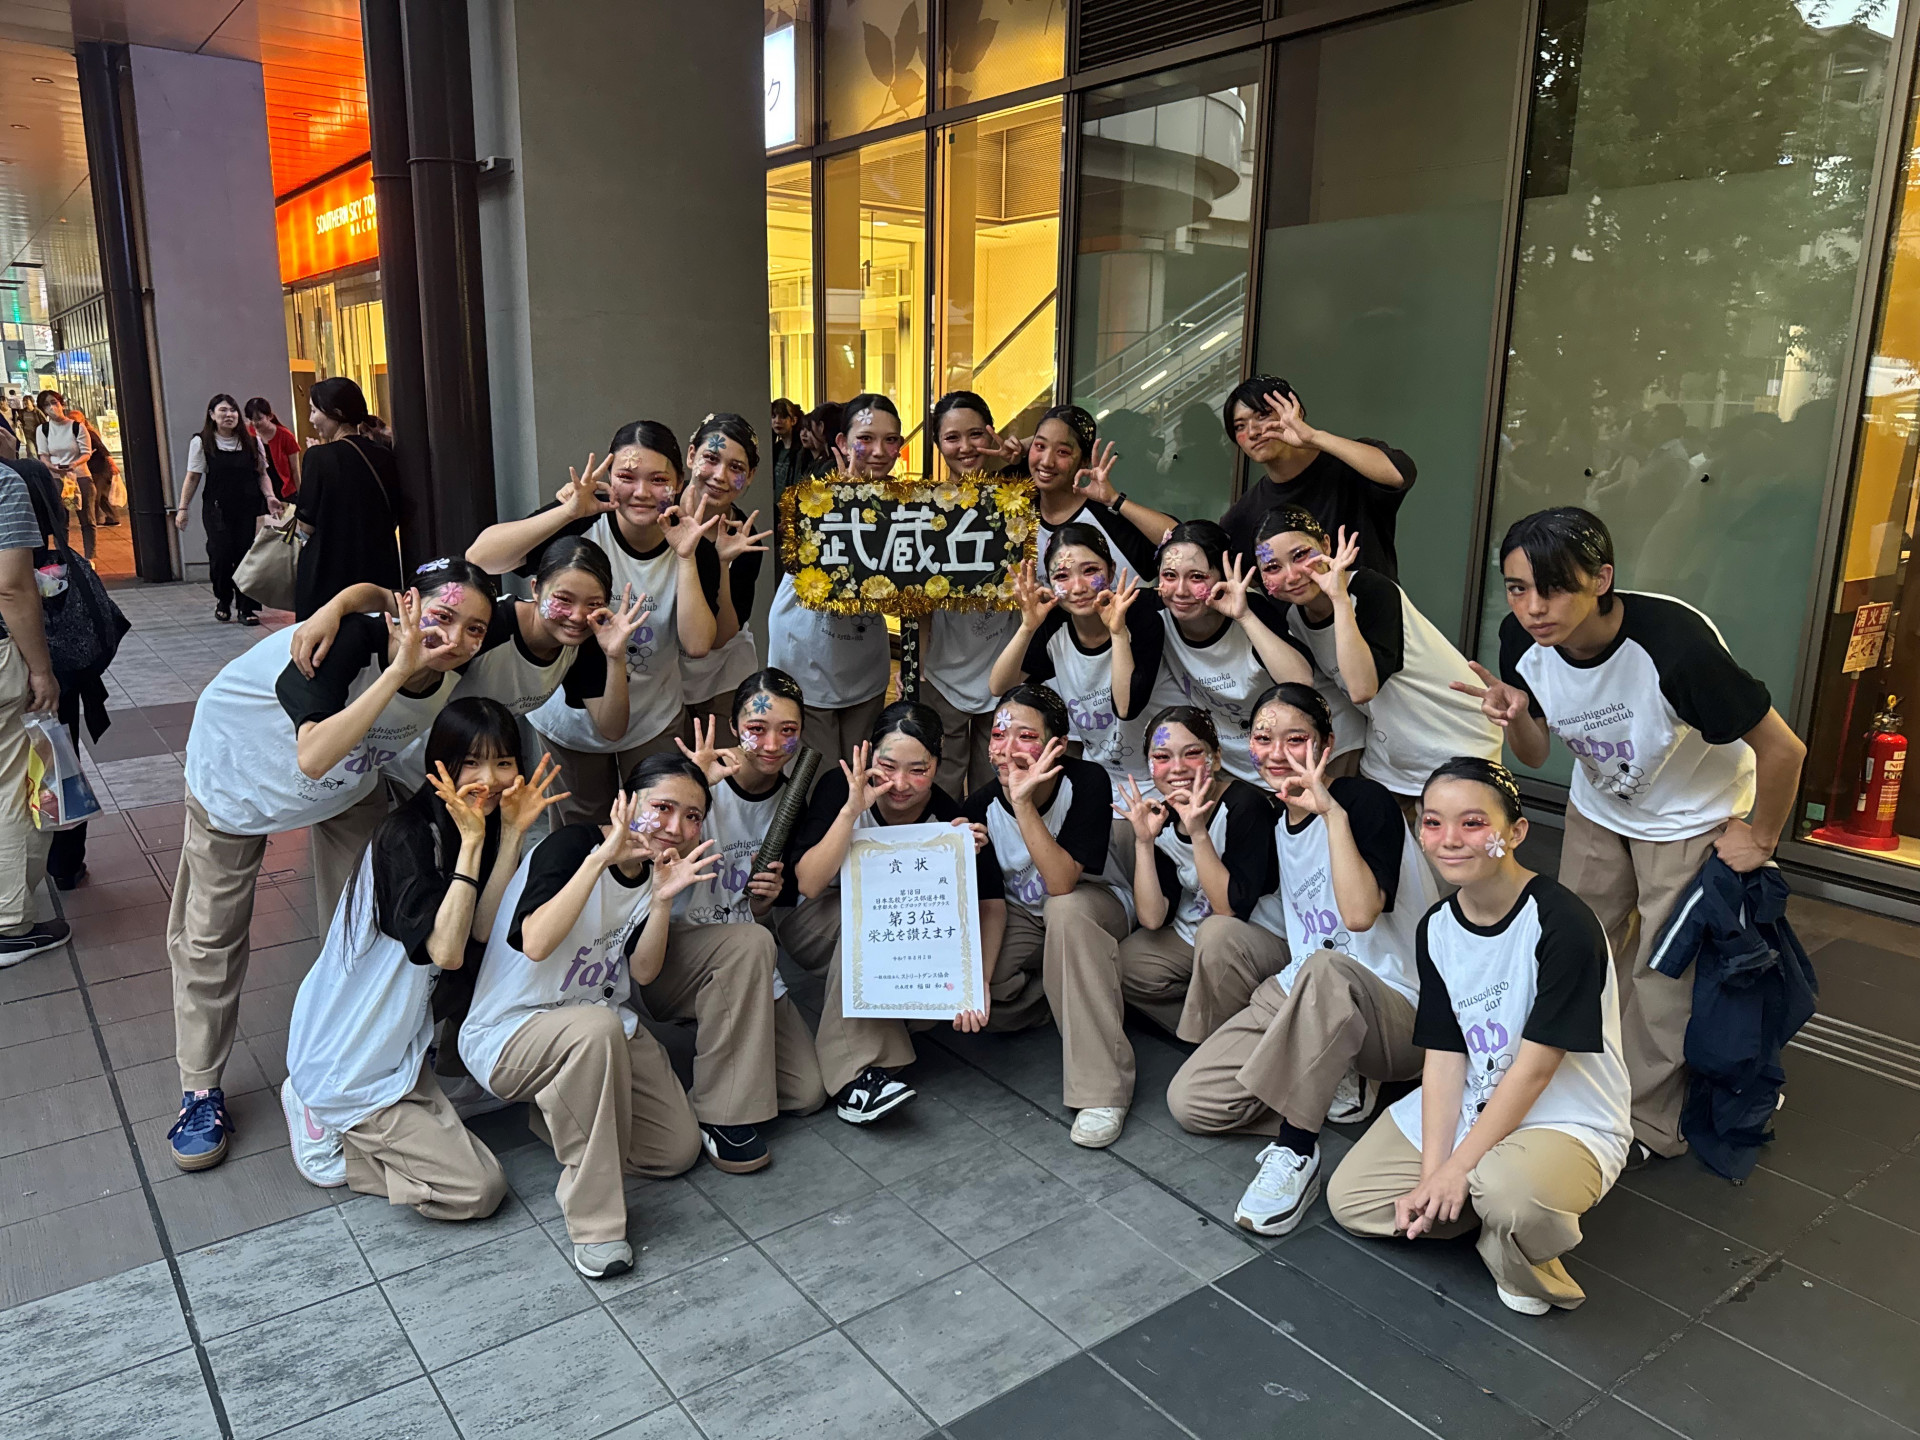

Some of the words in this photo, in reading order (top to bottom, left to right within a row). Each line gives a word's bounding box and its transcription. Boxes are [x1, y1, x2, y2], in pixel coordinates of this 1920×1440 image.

[316, 204, 349, 235] SOUTHERN
[349, 199, 362, 222] SKY
[862, 260, 870, 286] 1
[819, 504, 995, 574] 武蔵丘
[1857, 606, 1890, 627] 消火器
[1092, 695, 1112, 707] danc
[1558, 702, 1626, 727] musashigaoka
[1583, 709, 1634, 732] danceclub
[889, 857, 929, 874] 賞状
[938, 876, 948, 885] 殿
[888, 910, 936, 927] 第3位
[868, 926, 956, 943] 栄光を讃えます
